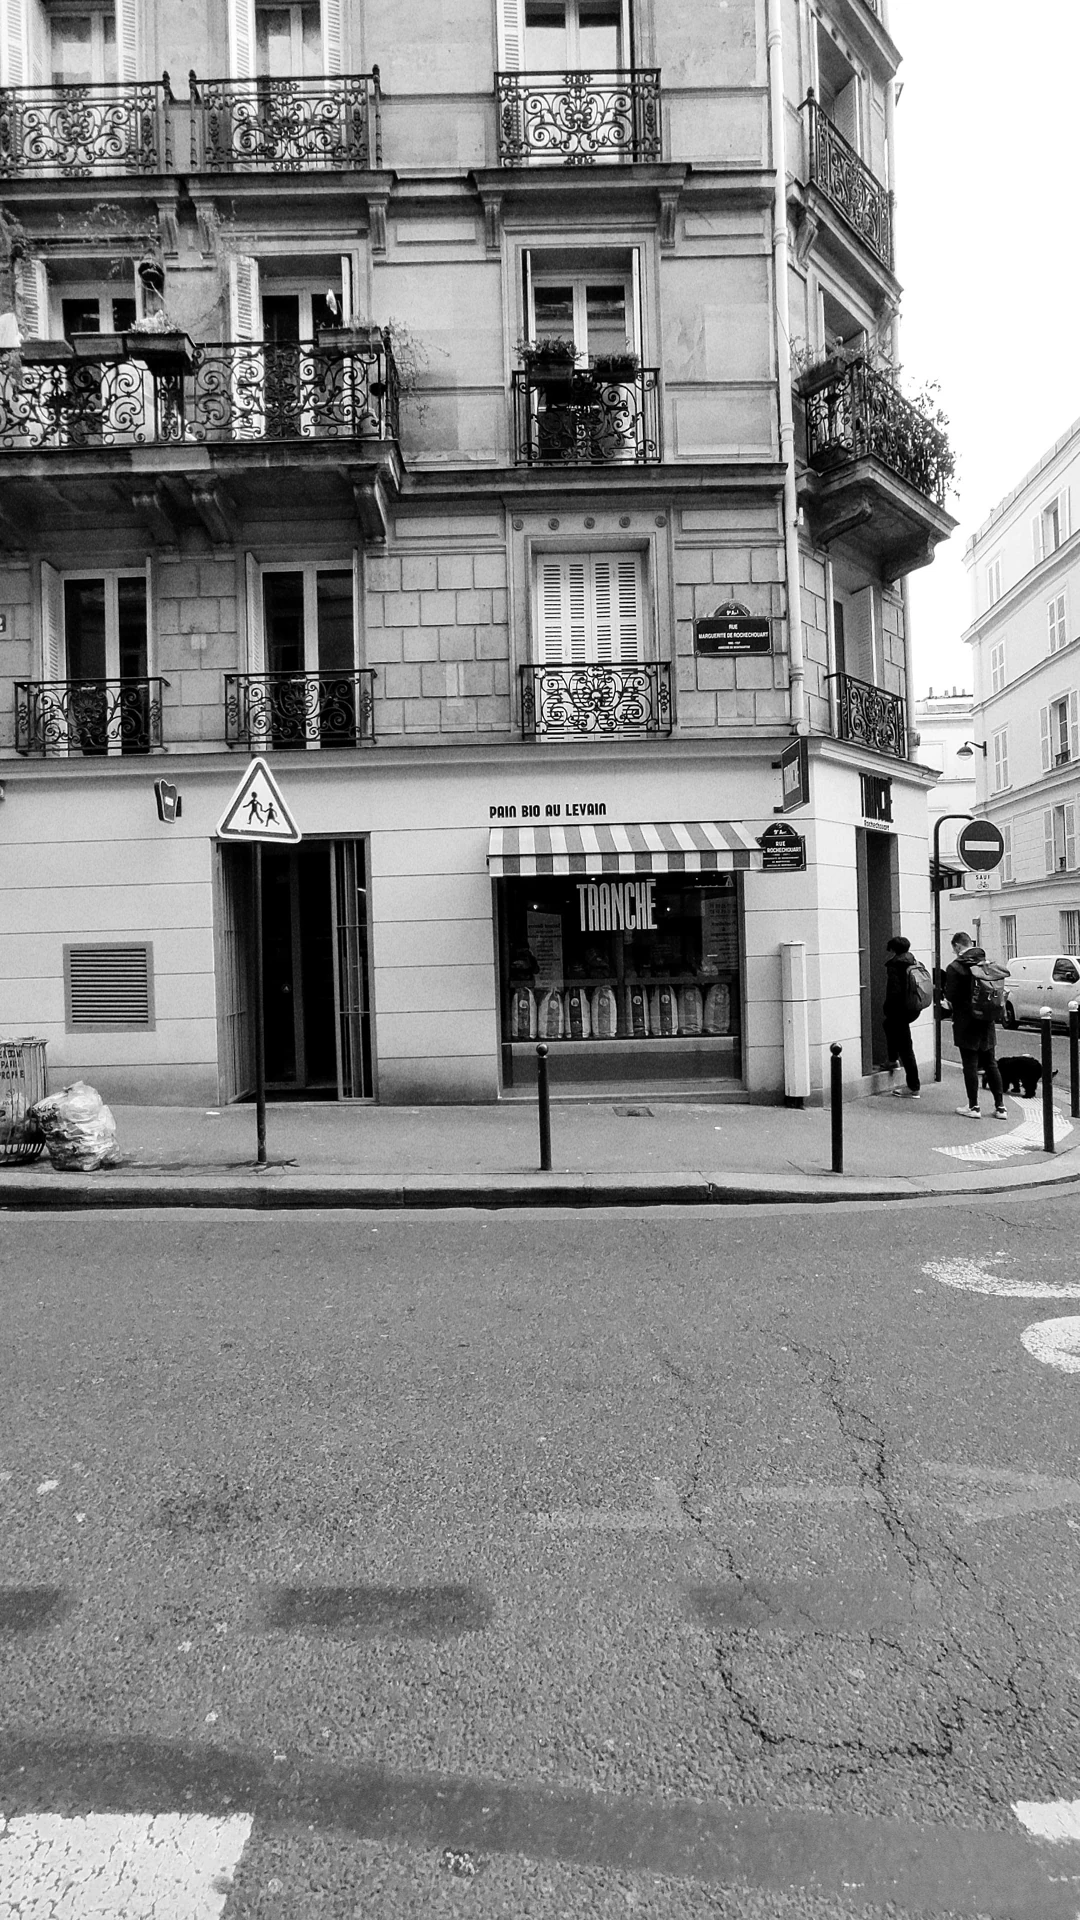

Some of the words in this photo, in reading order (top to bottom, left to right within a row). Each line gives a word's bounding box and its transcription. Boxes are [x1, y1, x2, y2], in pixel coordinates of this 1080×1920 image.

[489, 805, 517, 819] PAIN
[521, 804, 541, 818] BIO
[545, 804, 561, 817] AU
[565, 802, 607, 817] LEVAIN
